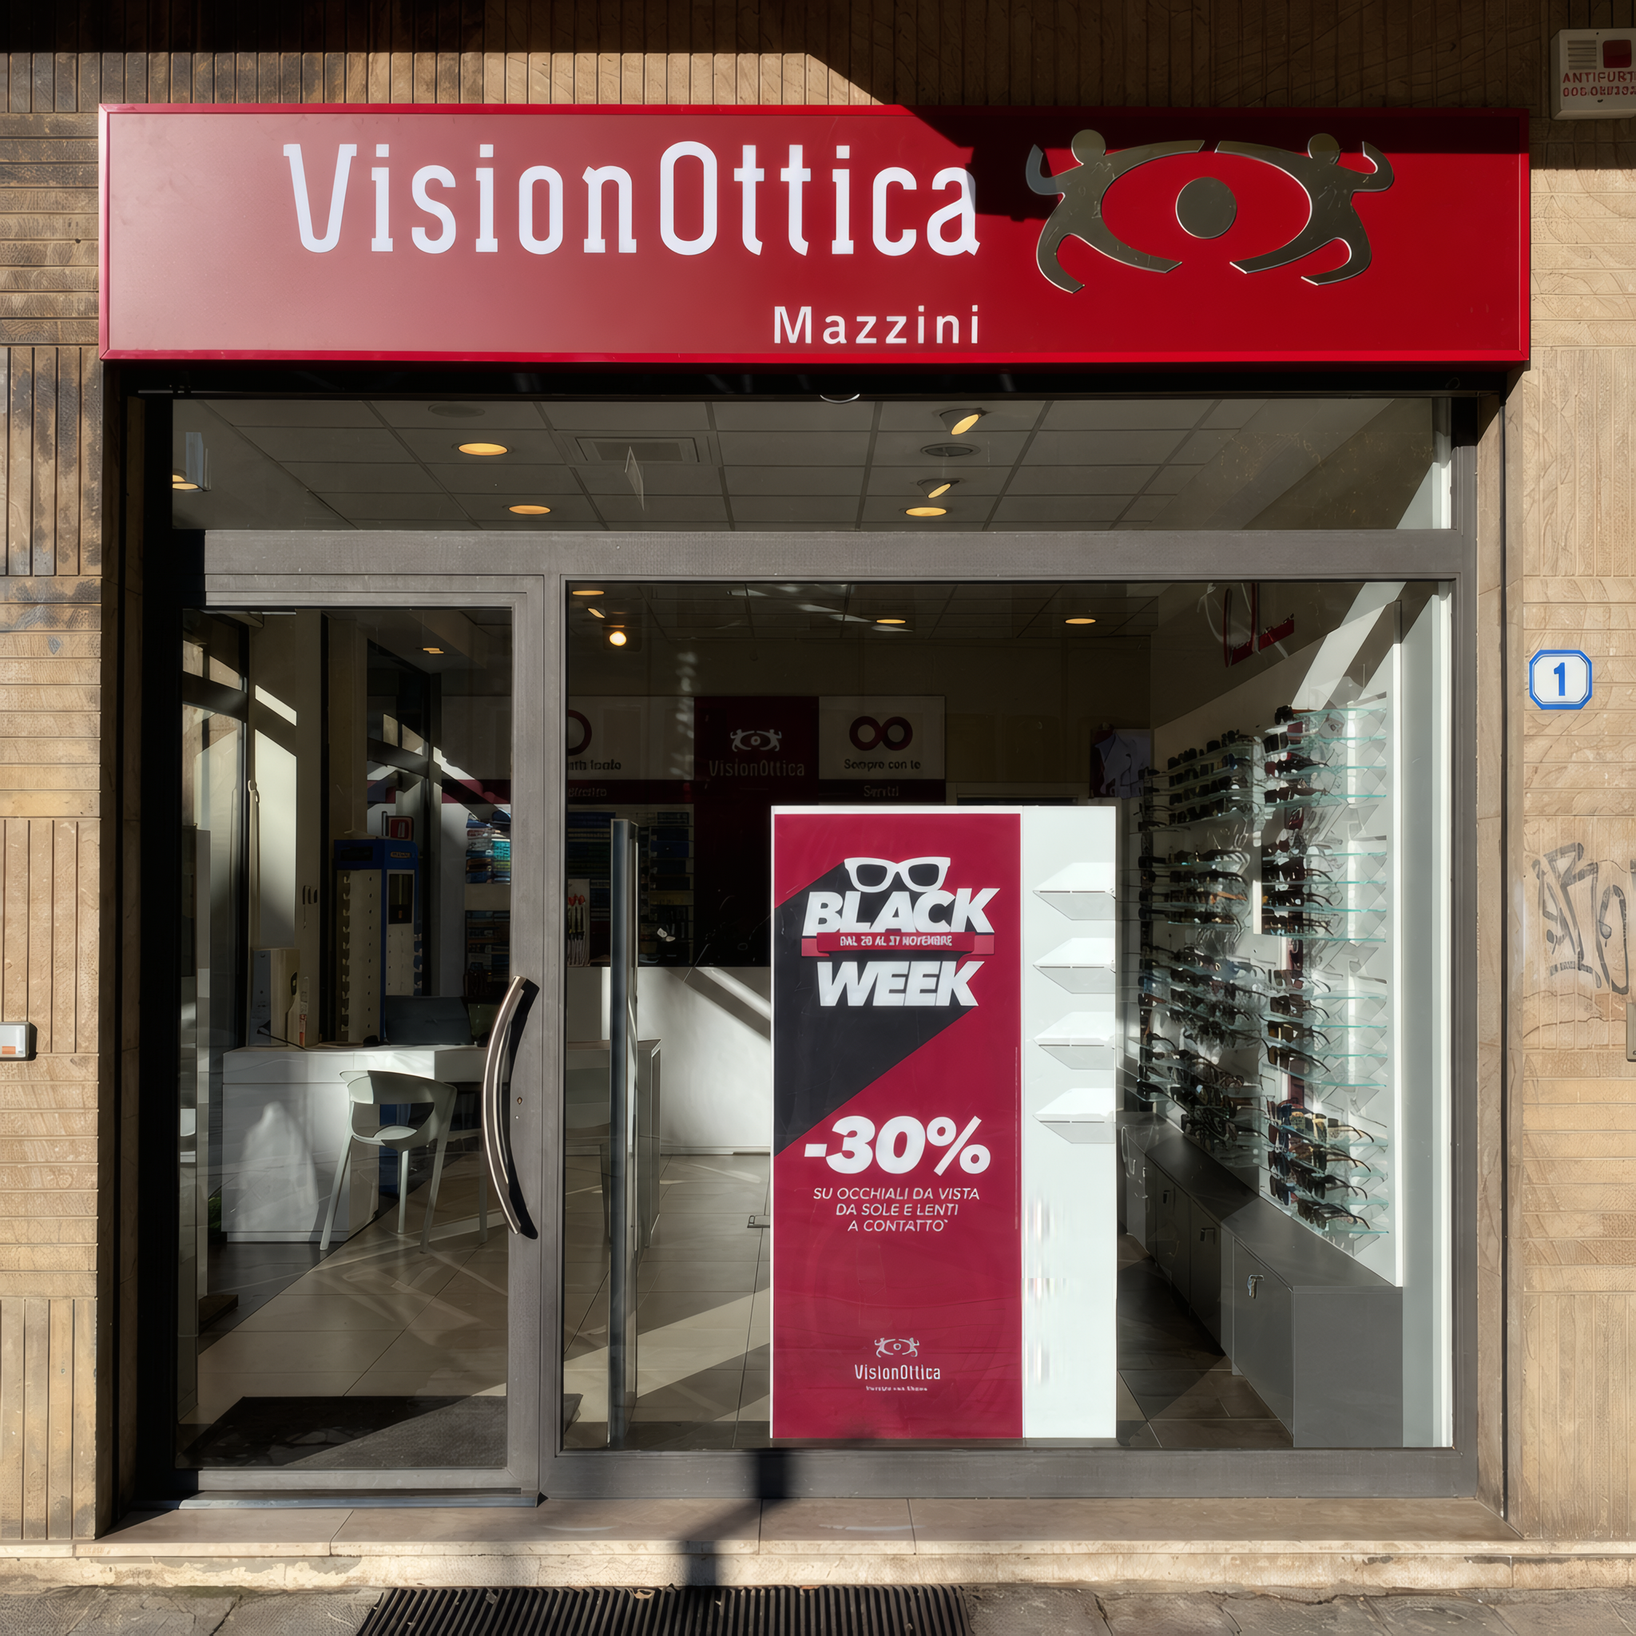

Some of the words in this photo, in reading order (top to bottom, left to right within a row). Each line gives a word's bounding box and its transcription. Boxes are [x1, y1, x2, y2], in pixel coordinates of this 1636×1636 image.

[283, 141, 980, 256] VisionOttica
[773, 305, 980, 345] Mazzini
[1553, 662, 1567, 697] 1
[708, 758, 806, 778] VisionOttica
[802, 888, 1001, 935] BLACK
[816, 960, 985, 1007] WEEK
[804, 1115, 991, 1176] -30%
[813, 1187, 833, 1200] SU
[837, 1187, 909, 1200] OCCHIALI
[912, 1187, 934, 1200] DA
[939, 1187, 980, 1200] VISTA
[836, 1203, 857, 1216] DA
[861, 1203, 900, 1216] SOLE
[904, 1203, 912, 1216] E
[917, 1203, 959, 1216] LENTI
[847, 1219, 859, 1232] A
[863, 1219, 946, 1232] CONTATTO
[854, 1364, 941, 1380] VisionOttica
